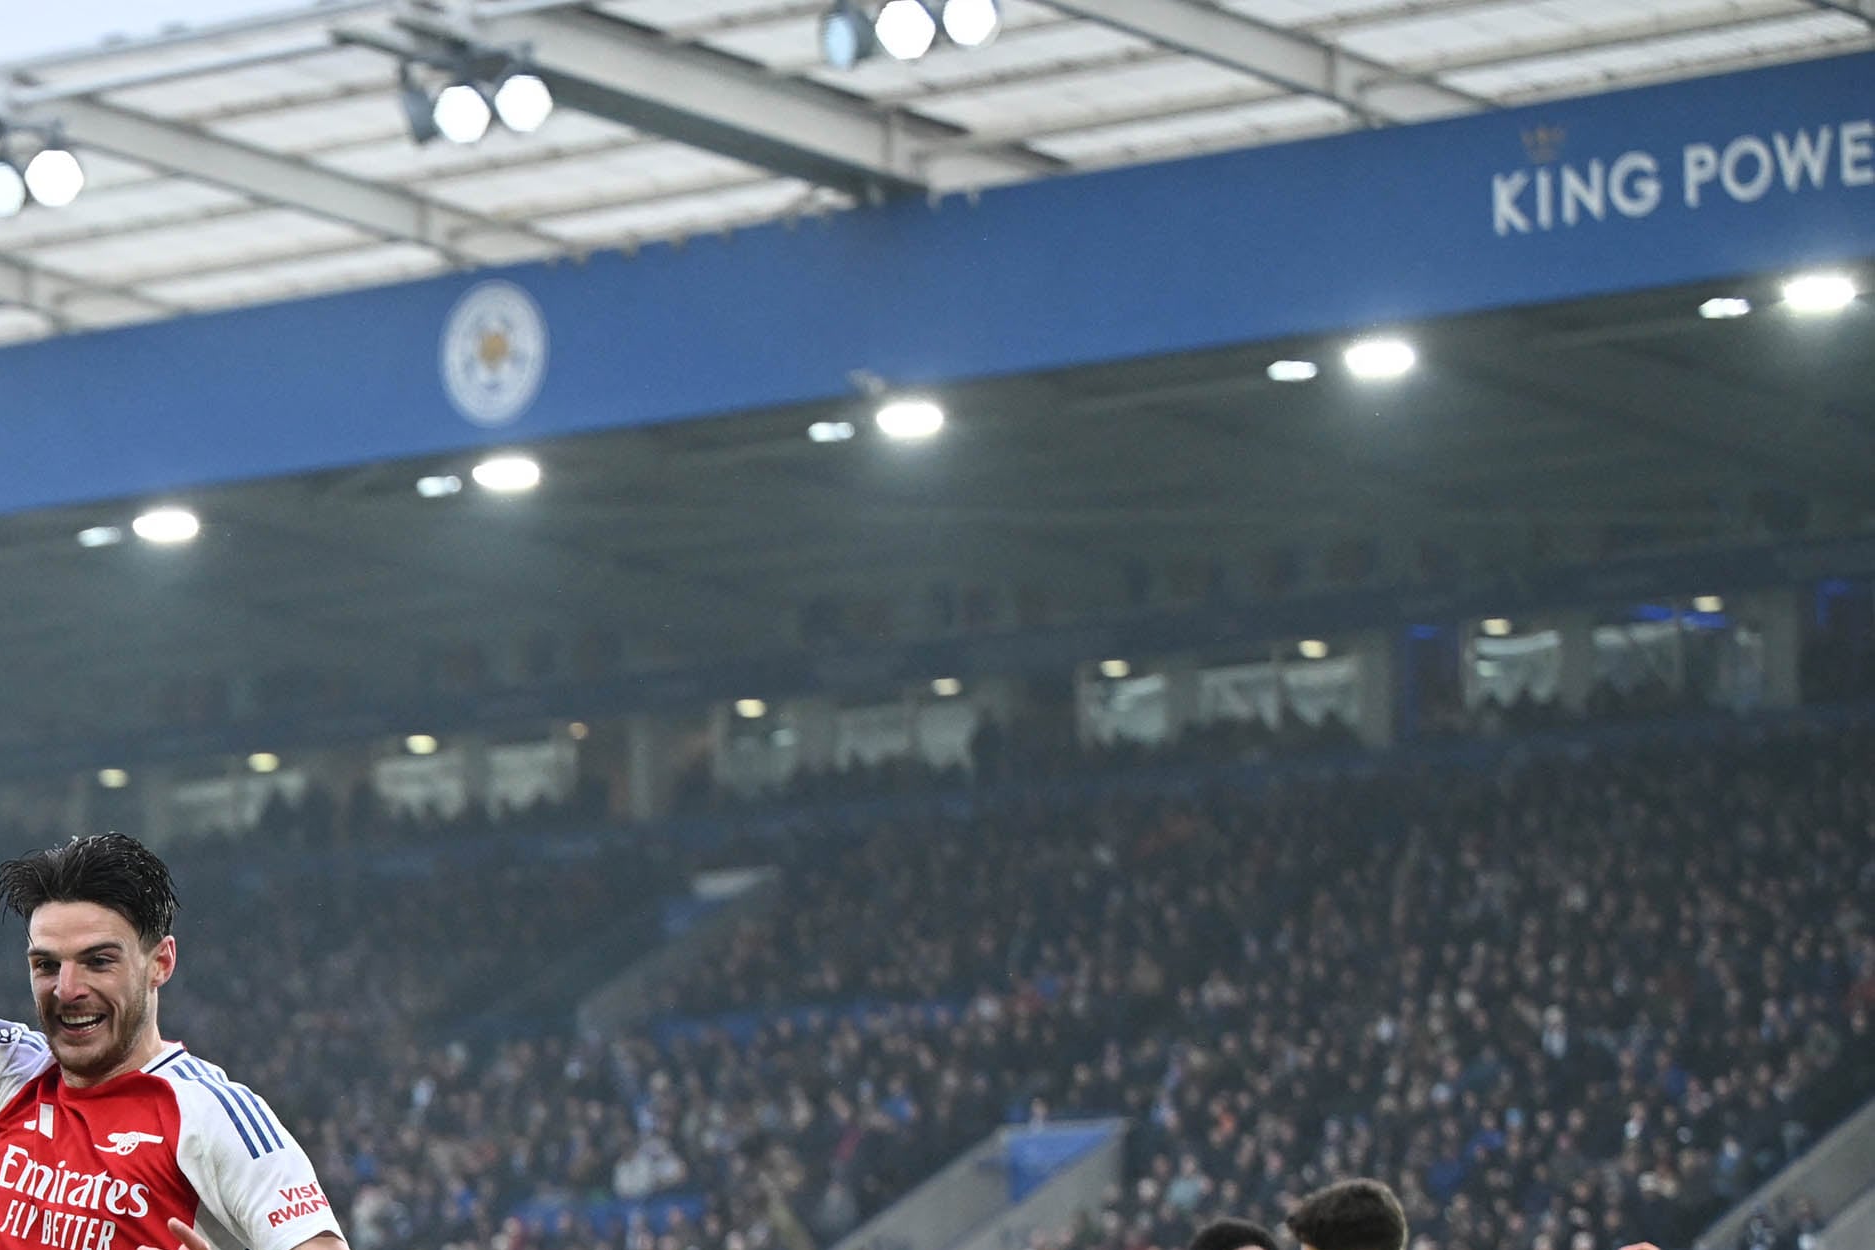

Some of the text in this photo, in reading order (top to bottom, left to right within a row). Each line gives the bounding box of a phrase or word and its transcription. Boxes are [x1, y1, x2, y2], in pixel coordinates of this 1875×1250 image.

[1492, 150, 1662, 236] KING
[278, 1181, 318, 1202] VISI
[0, 1199, 39, 1240] FLY
